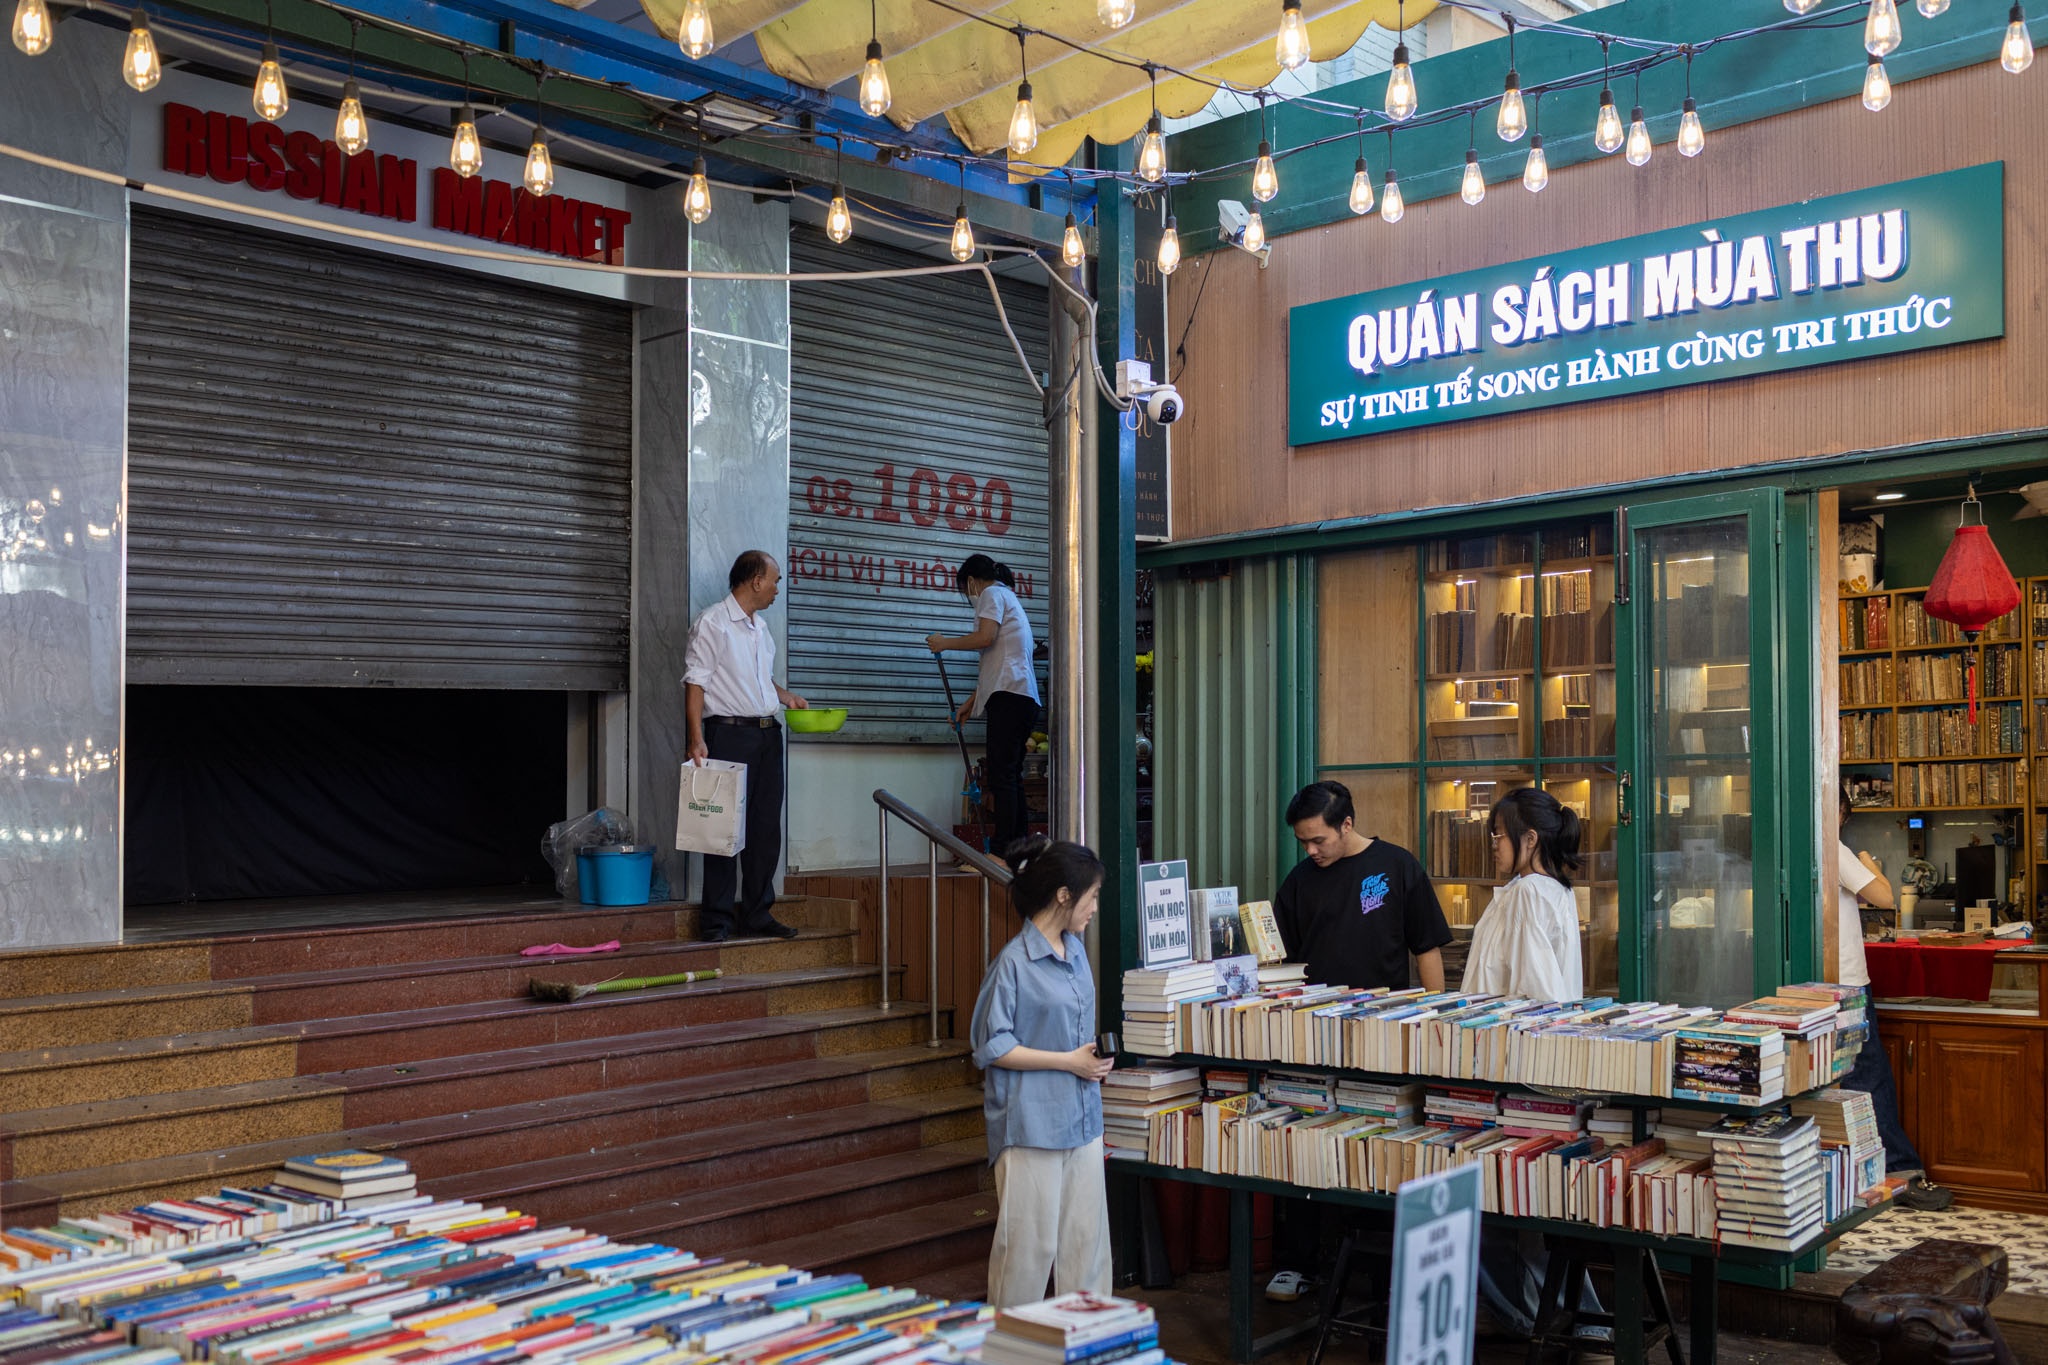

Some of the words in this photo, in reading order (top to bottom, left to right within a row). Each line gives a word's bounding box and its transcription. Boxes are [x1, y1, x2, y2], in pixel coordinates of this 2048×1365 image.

[163, 101, 417, 223] RUSSIAN
[433, 166, 631, 266] MARKET
[1347, 289, 1481, 375] QUÁN
[1490, 266, 1632, 346] SÁCH
[1643, 228, 1778, 319] MÙA
[1781, 208, 1908, 294] THU
[1320, 394, 1355, 429] SỰ
[1360, 385, 1429, 420] TINH
[1434, 366, 1474, 409] TẾ
[1477, 363, 1560, 402] SONG
[1566, 349, 1660, 387] HÀNH
[1667, 331, 1766, 370] CÙNG
[1772, 317, 1836, 353] TRI
[1843, 294, 1952, 342] THỨC
[790, 547, 839, 585] ỊCH
[848, 553, 886, 594] VỤ
[894, 557, 958, 594] THÔ
[1147, 902, 1165, 921] VĂN
[1167, 901, 1185, 922] HỌC
[1149, 931, 1166, 950] VĂN
